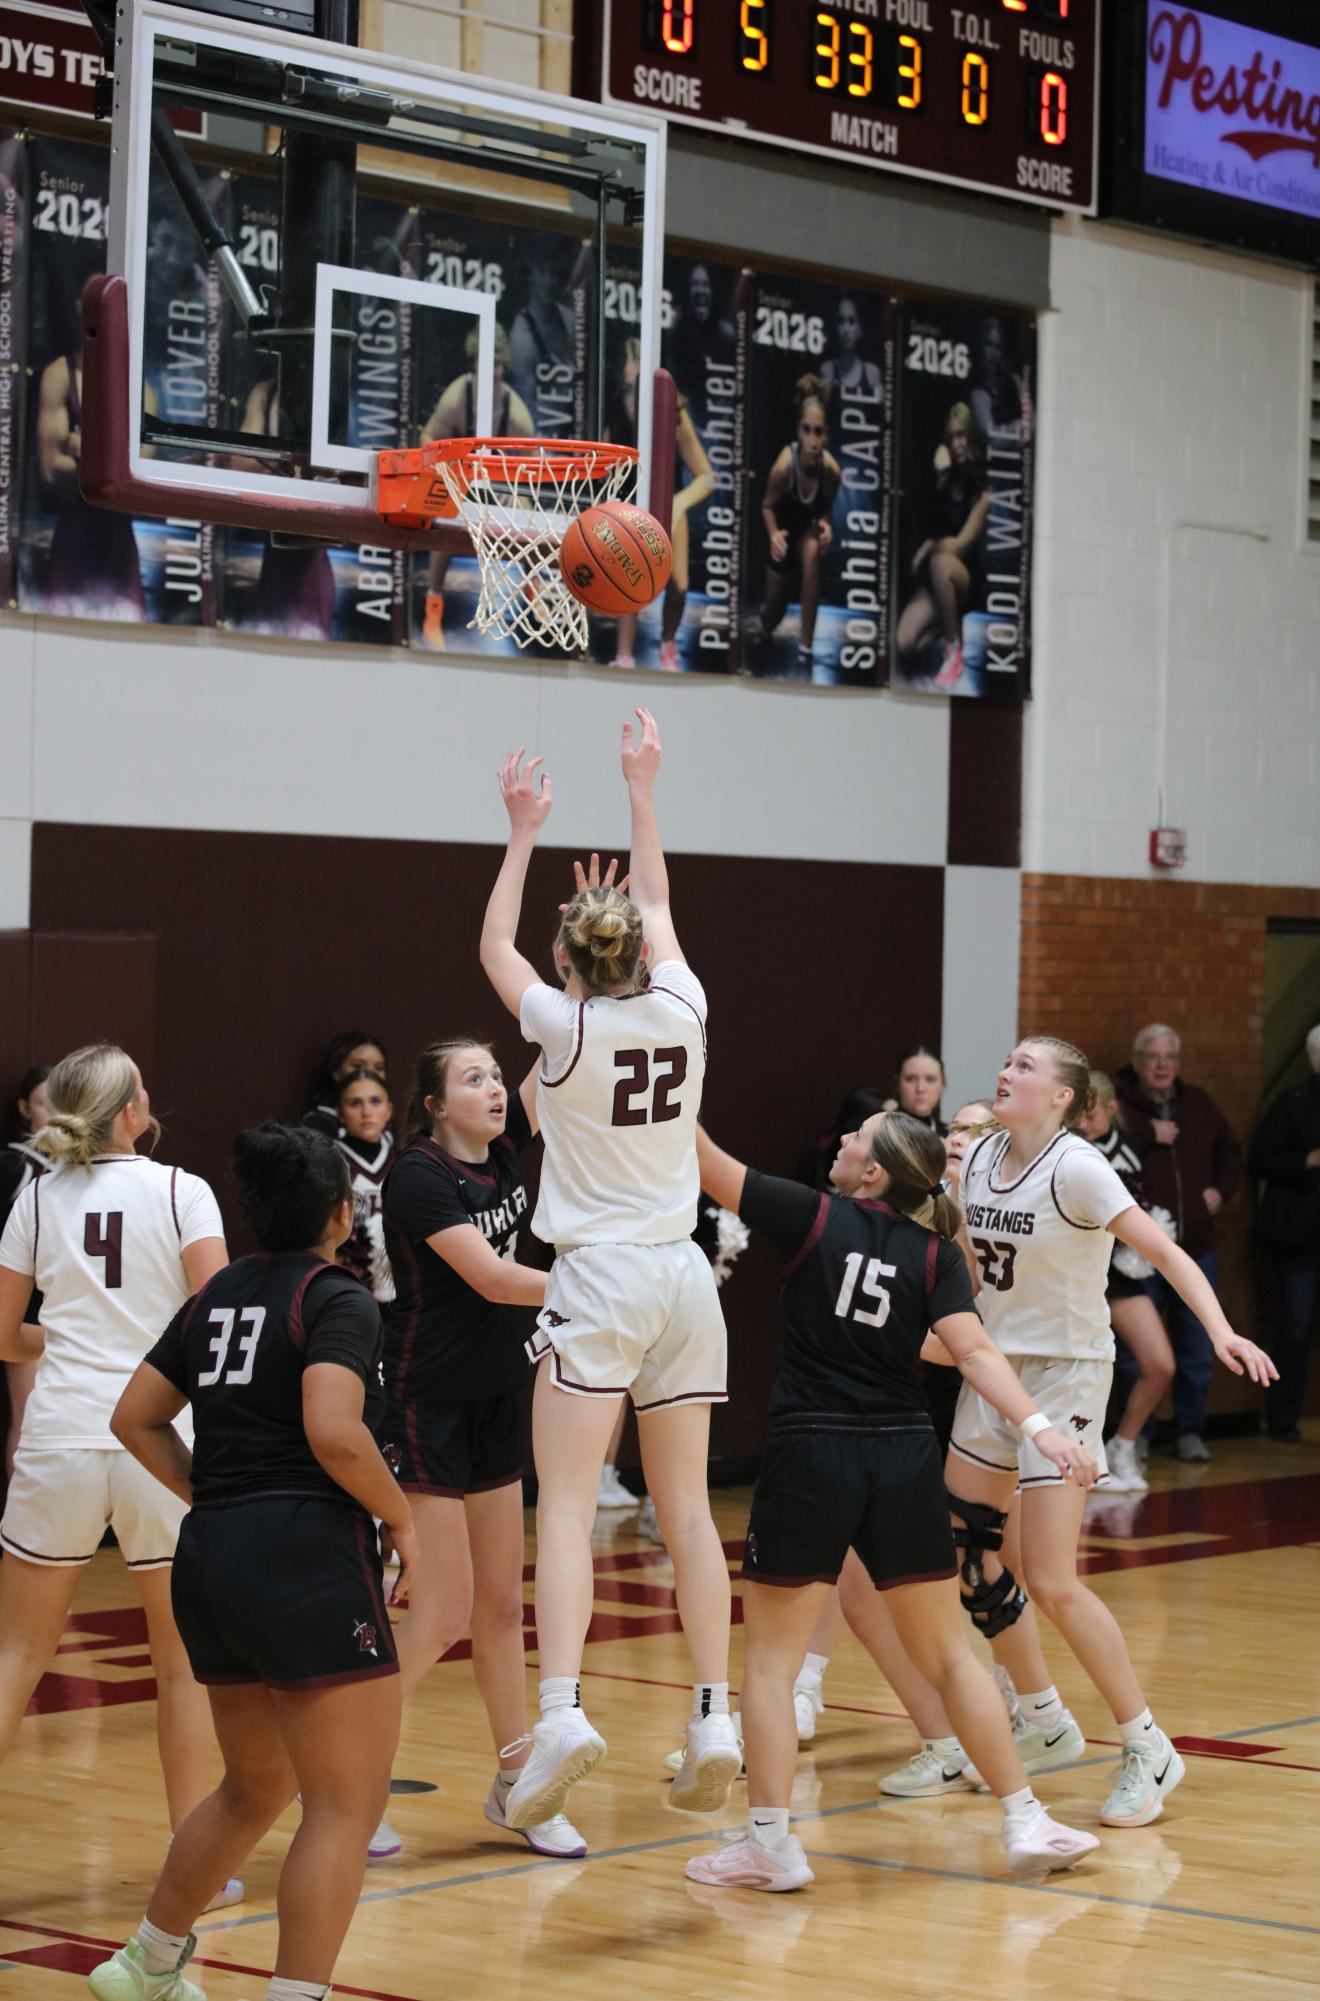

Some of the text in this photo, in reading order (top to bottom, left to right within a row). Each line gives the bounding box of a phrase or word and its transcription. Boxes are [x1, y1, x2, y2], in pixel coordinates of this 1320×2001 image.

[898, 35, 922, 109] 3
[962, 52, 988, 125] 0
[1019, 28, 1075, 69] FOULS
[633, 64, 702, 110] SCORE
[1040, 72, 1067, 145] 0
[831, 111, 899, 155] MATCH
[39, 170, 86, 193] Senior
[1016, 155, 1073, 196] SCORE
[1, 187, 17, 283] WRESTLING
[32, 190, 109, 241] 202
[0, 290, 12, 360] SCHOOL
[604, 279, 677, 329] 206
[752, 307, 827, 355] 2026
[0, 366, 11, 410] HIGH
[905, 334, 972, 379] 2026
[0, 416, 11, 488] CENTRAL
[591, 519, 647, 588] SPALDING
[699, 505, 735, 650] Phoebe
[839, 510, 881, 670] Sophia
[986, 573, 1021, 673] KODI
[612, 1045, 688, 1126] 22
[84, 1211, 123, 1289] 4
[966, 1203, 1036, 1236] USTANGS
[834, 1252, 897, 1328] 15
[198, 1306, 267, 1388] 33
